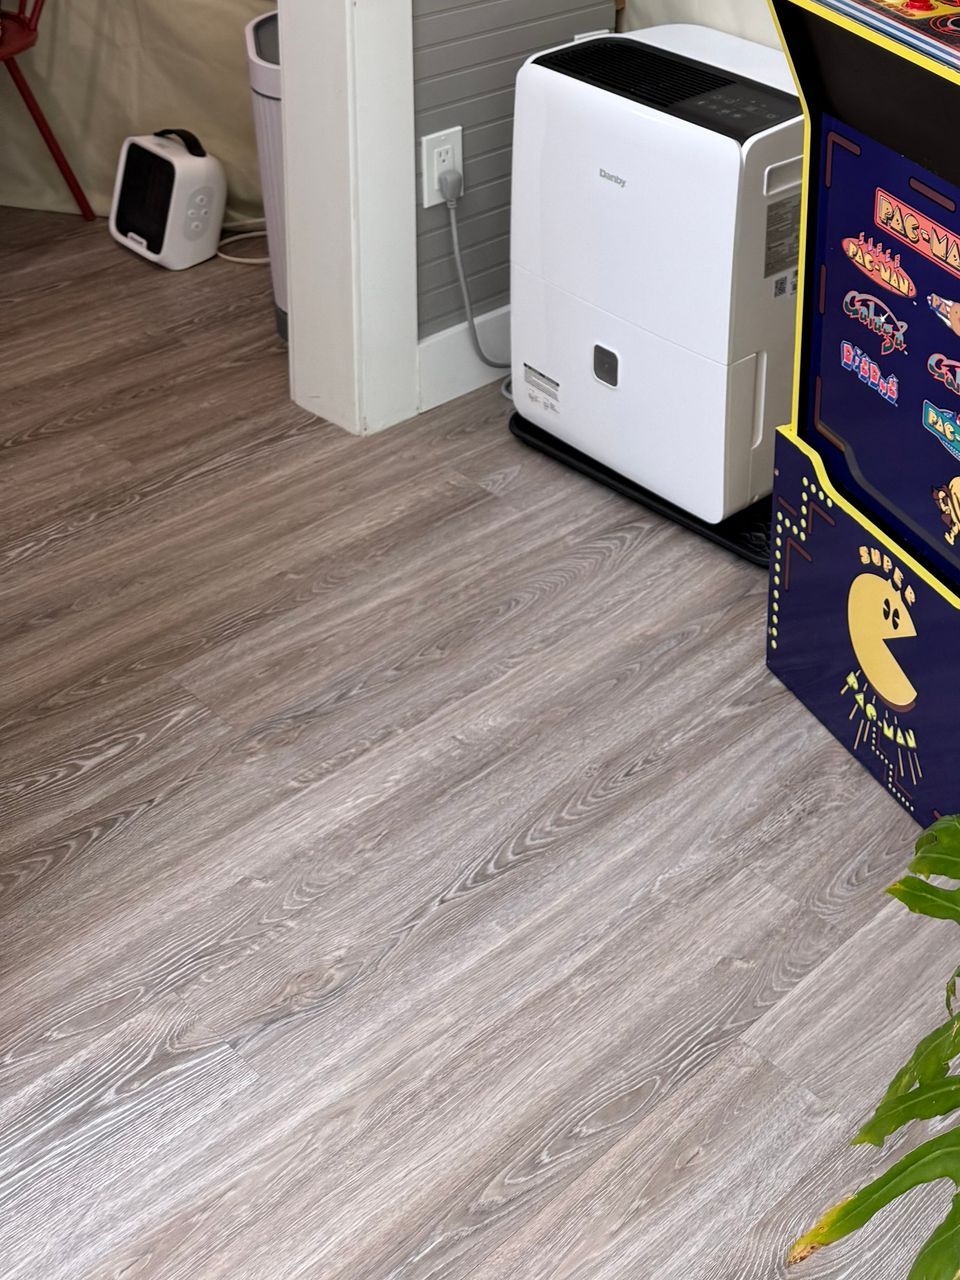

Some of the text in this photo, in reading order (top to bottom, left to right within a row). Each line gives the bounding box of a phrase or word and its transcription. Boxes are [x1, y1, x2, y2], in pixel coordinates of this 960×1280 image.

[847, 241, 911, 297] PAC-MAN
[858, 545, 917, 607] SUPER
[845, 671, 917, 749] PAC-MAN
